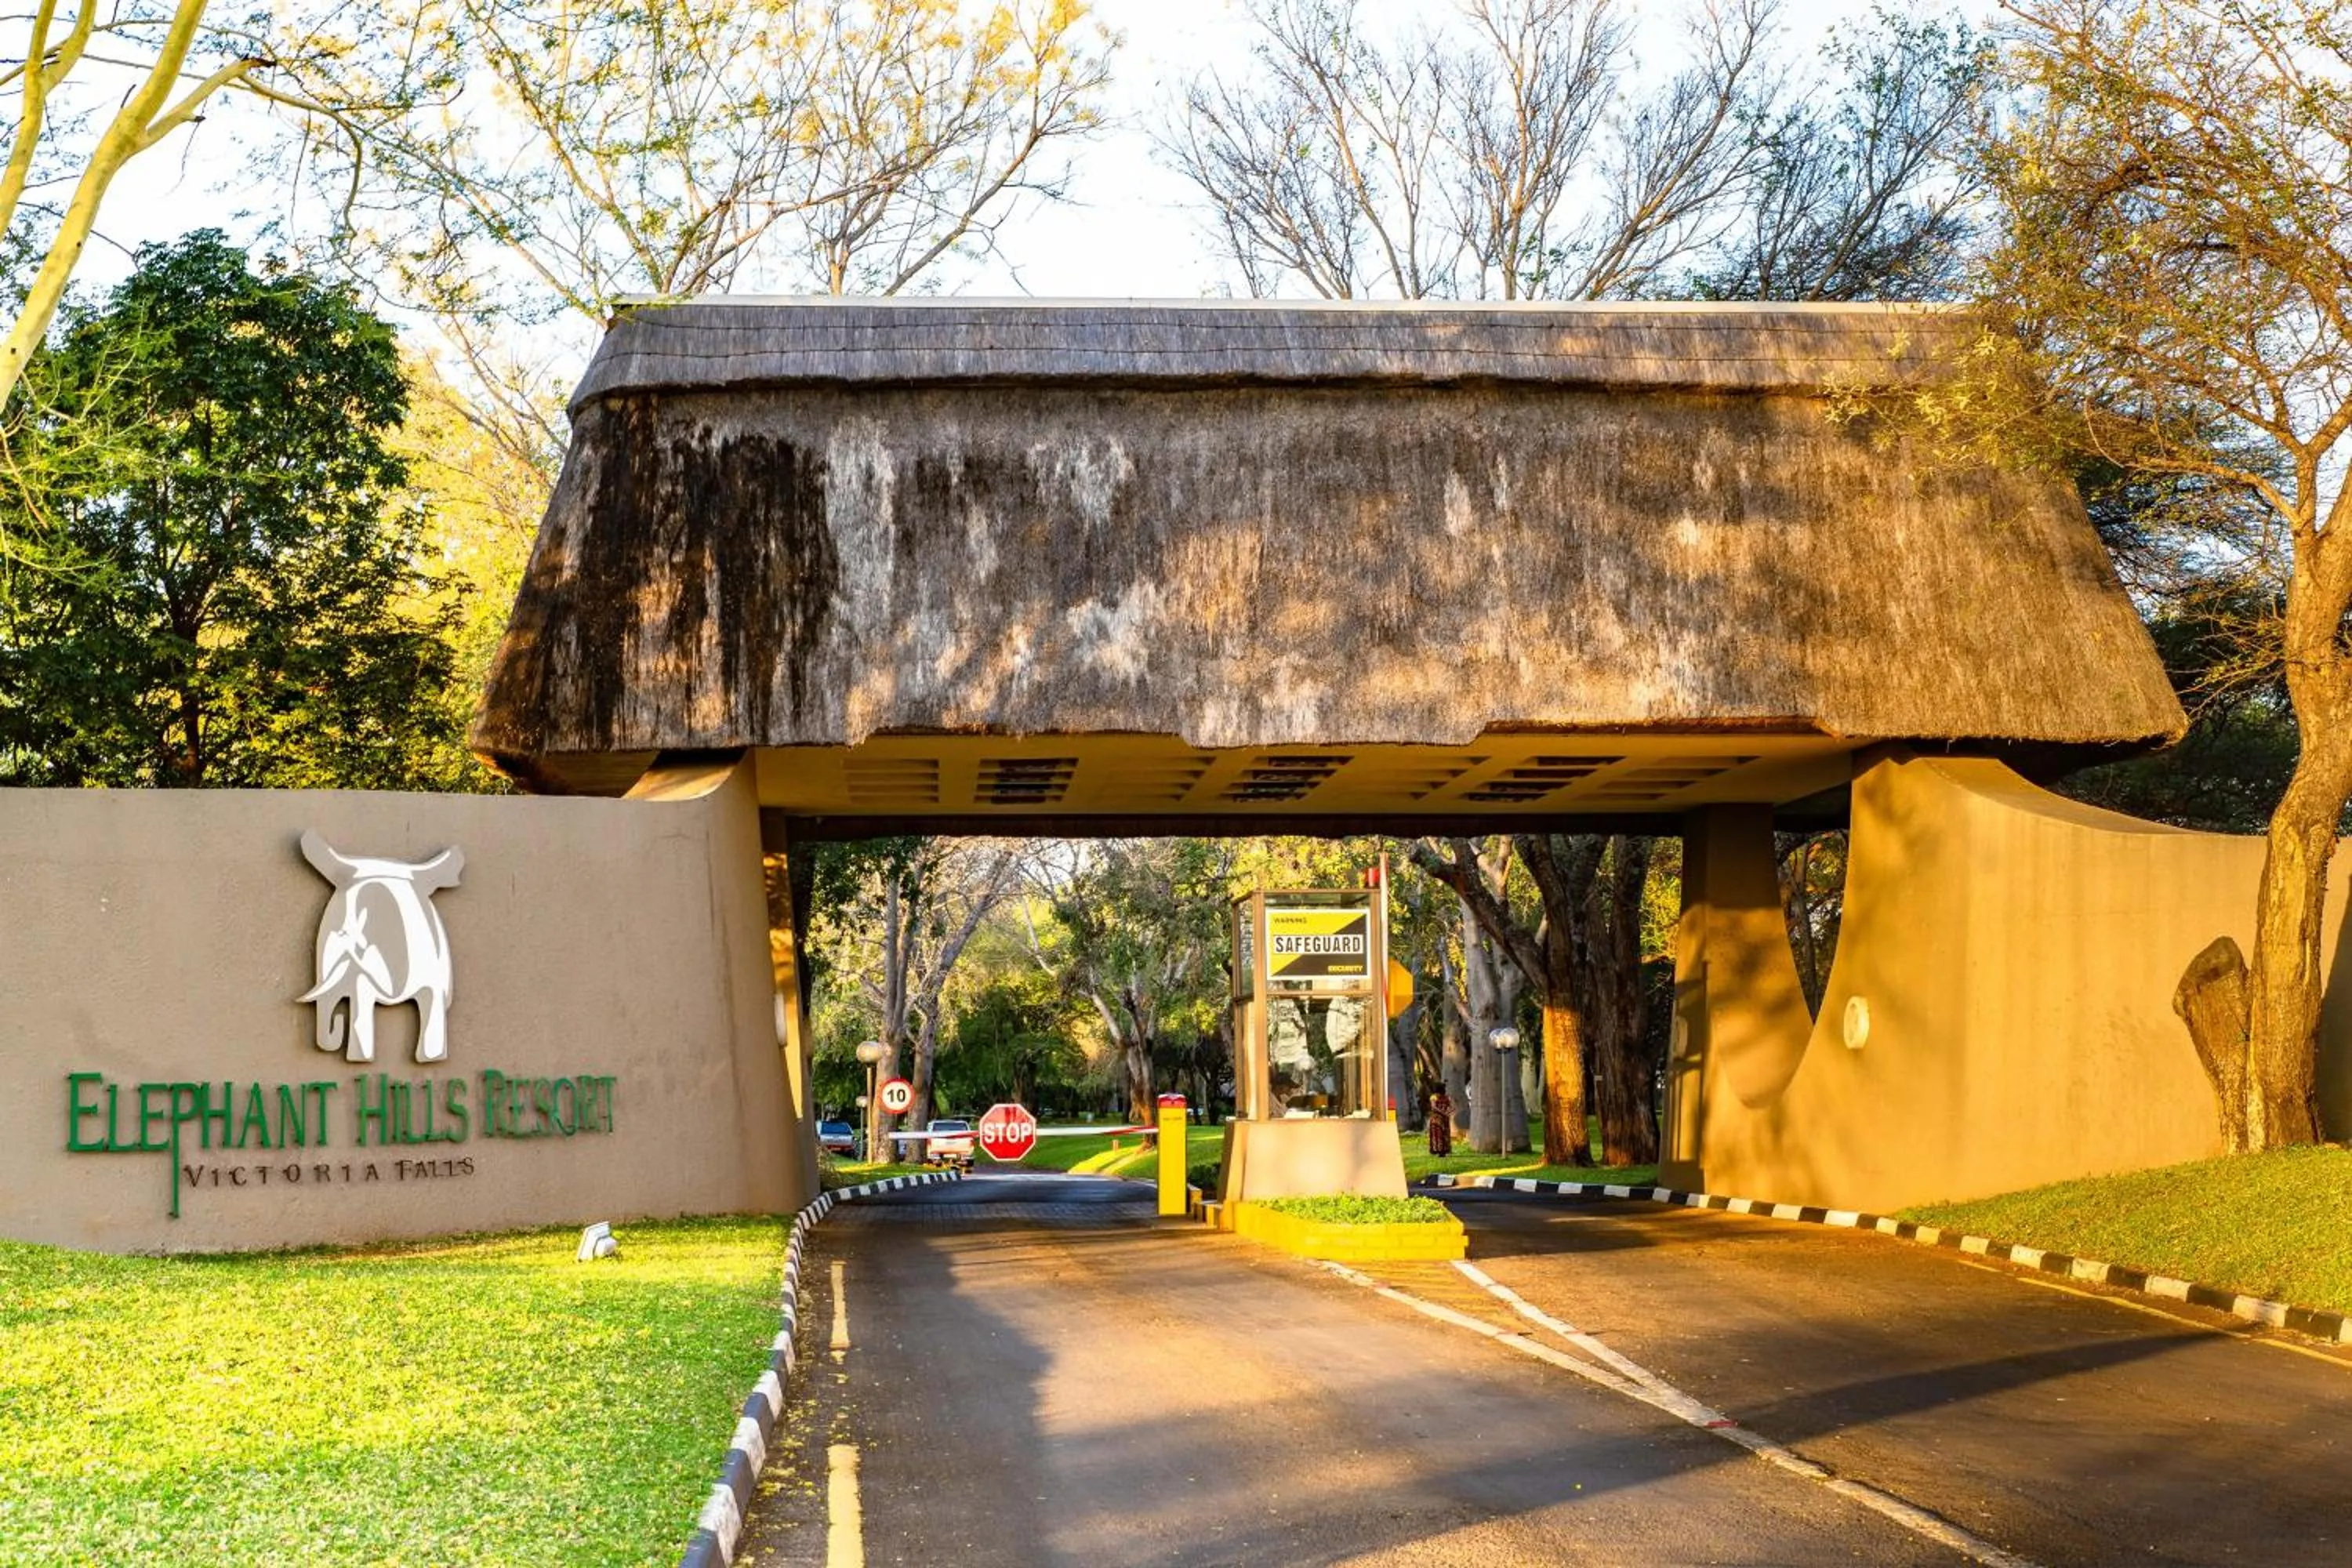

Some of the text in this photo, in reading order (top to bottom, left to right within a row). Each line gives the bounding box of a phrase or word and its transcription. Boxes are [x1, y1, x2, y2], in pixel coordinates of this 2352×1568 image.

[1276, 936, 1361, 953] SAFEGUARD
[887, 1088, 906, 1103] 10
[67, 1068, 617, 1218] ELEPHANT HILLS RESORT
[984, 1122, 1033, 1144] STOP
[183, 1156, 475, 1188] VICTORIA FALLS
